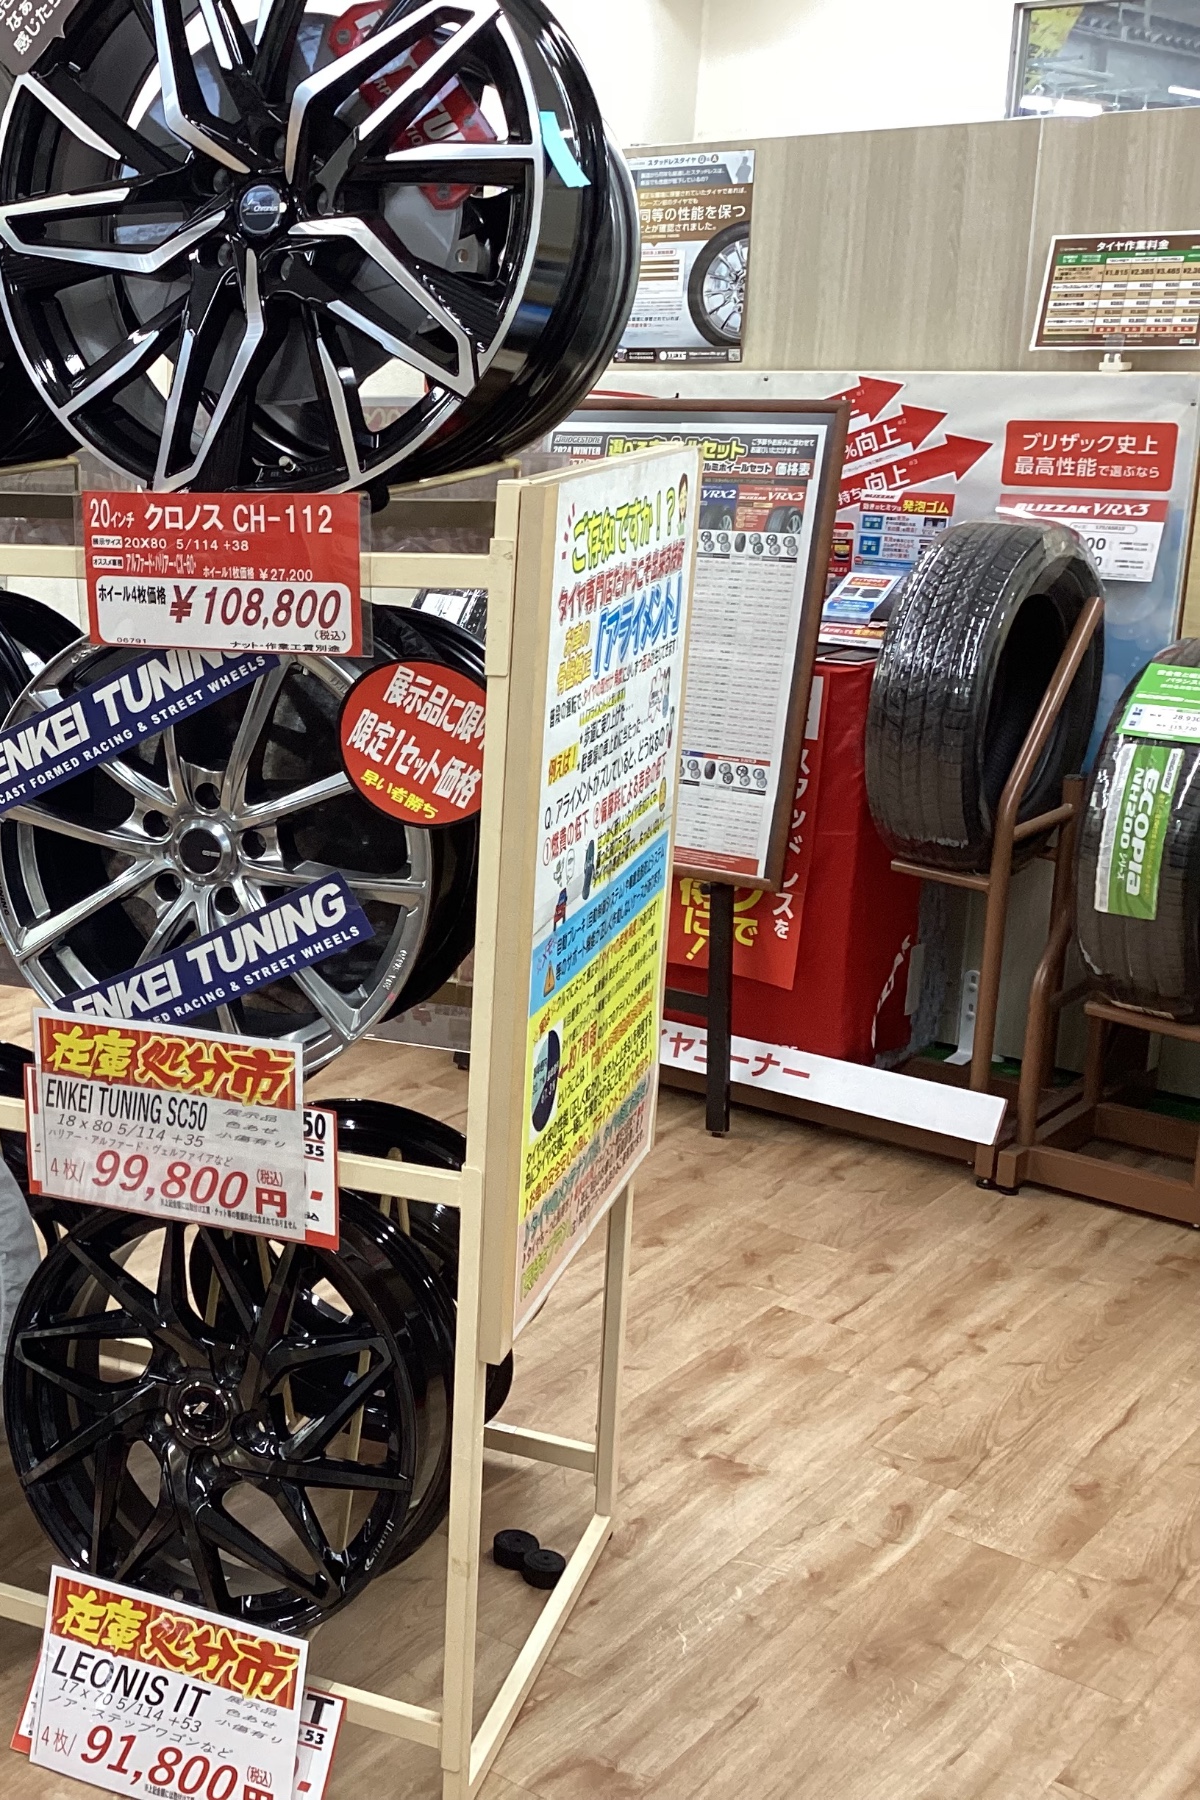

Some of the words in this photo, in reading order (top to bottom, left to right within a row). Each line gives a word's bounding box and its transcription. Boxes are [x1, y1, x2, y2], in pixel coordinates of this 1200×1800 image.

[640, 204, 745, 223] 同等の性能を保つ
[1097, 240, 1169, 251] タイヤ作業料金
[1022, 433, 1159, 456] ブリザック史上
[776, 462, 810, 476] 価格表
[1014, 456, 1160, 479] 最高性能で選ぶなら
[89, 498, 135, 529] 20インチ
[144, 503, 224, 532] クロノス
[232, 504, 333, 534] CH-112
[902, 500, 948, 513] 発泡ゴム
[1093, 503, 1150, 516] VRX3
[124, 538, 167, 549] 20X80
[176, 539, 218, 551] 5/114
[223, 540, 249, 551] +38
[202, 566, 254, 580] ホイール1枚価格
[98, 585, 166, 606] ホイール4枚価格
[169, 585, 342, 630] ¥108,800
[116, 636, 147, 644] 06791
[29, 756, 80, 788] FORMED
[82, 729, 133, 762] RACING
[137, 722, 148, 733] &
[150, 689, 203, 725] STREET
[207, 655, 266, 695] WHEELS
[361, 769, 439, 819] 早い者勝ち
[1120, 767, 1145, 849] NH200
[185, 882, 347, 985] TUNING
[174, 986, 226, 1018] RACING
[229, 981, 240, 992] &
[243, 954, 297, 985] STREET
[300, 925, 360, 959] WHEELS
[47, 1025, 296, 1107] 在庫処分市
[46, 1079, 94, 1113] ENKEI
[98, 1087, 162, 1125] TUNING
[166, 1101, 208, 1131] SC50
[57, 1113, 75, 1127] 18
[93, 1120, 112, 1135] 80
[117, 1123, 166, 1143] 5/114
[171, 1133, 205, 1148] +35
[57, 1589, 299, 1700] 在庫処分市
[51, 1644, 170, 1707] LEONIS
[172, 1683, 211, 1719] IT
[58, 1678, 76, 1694] 17
[93, 1689, 113, 1707] 70
[115, 1696, 165, 1723] 5/114
[169, 1715, 203, 1734] +53
[225, 1708, 278, 1729] 色あせ
